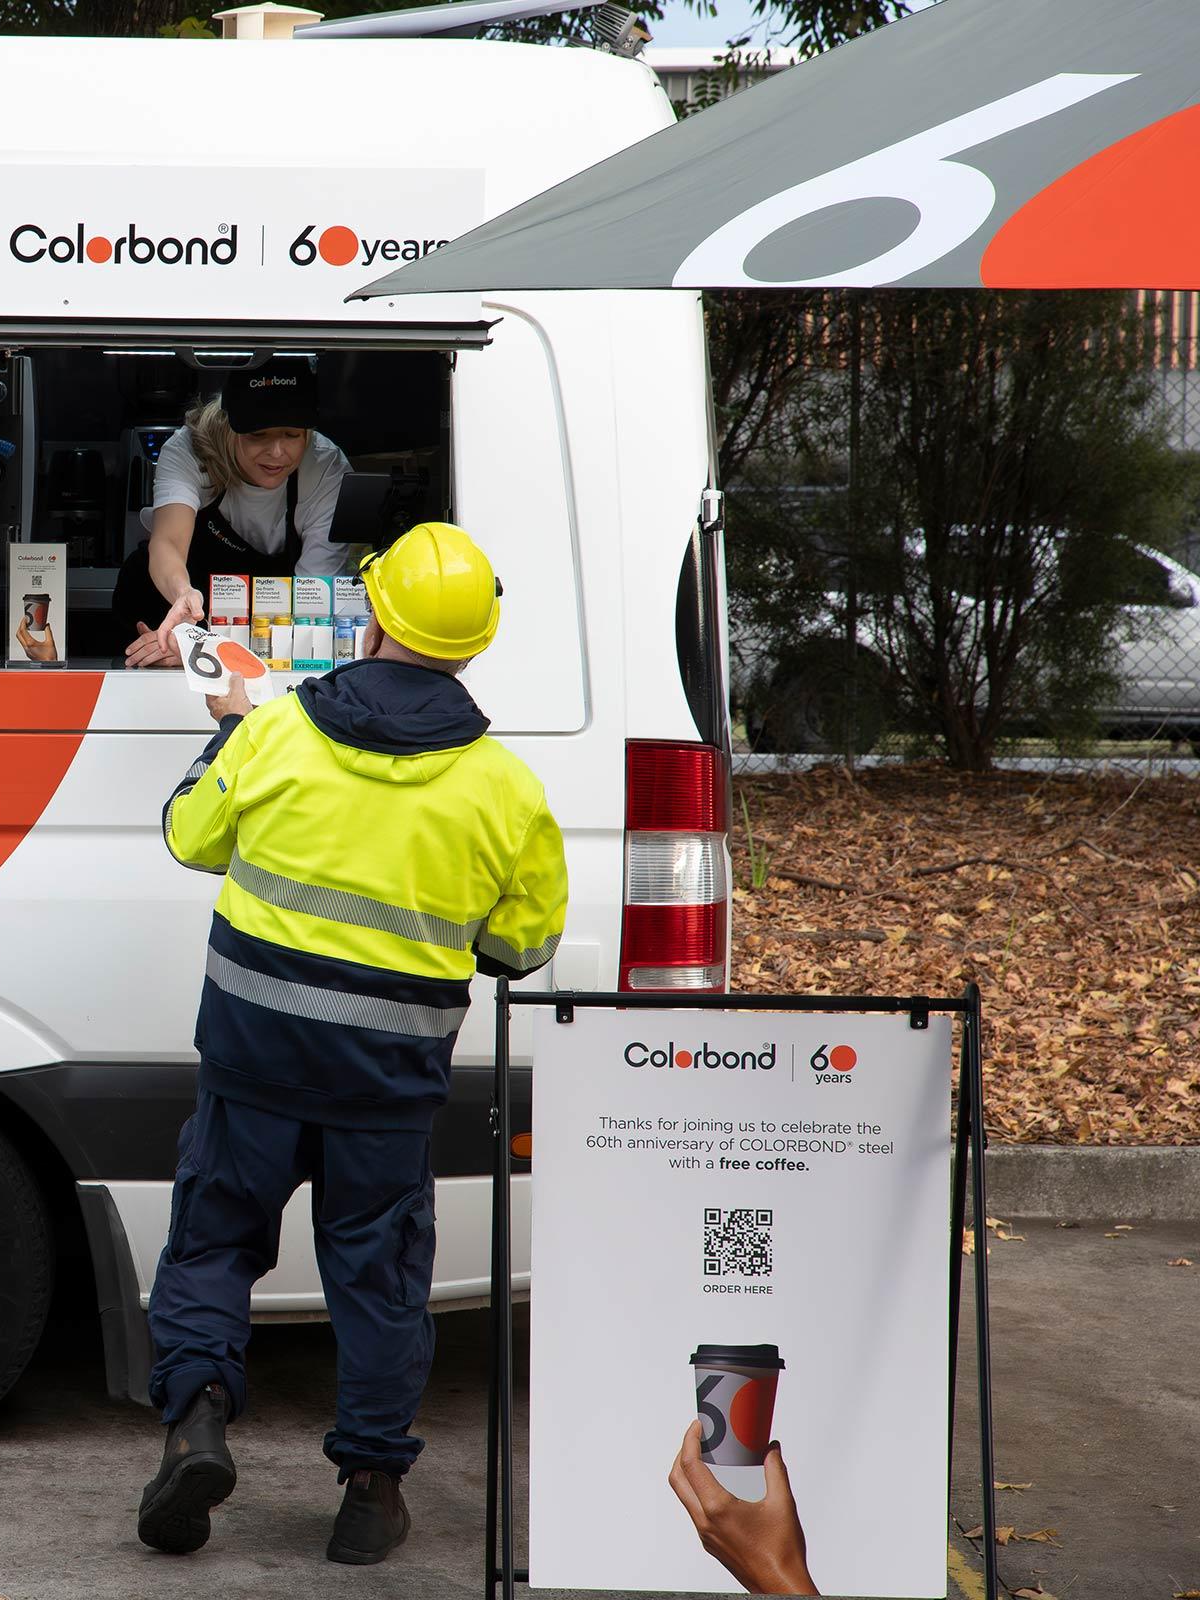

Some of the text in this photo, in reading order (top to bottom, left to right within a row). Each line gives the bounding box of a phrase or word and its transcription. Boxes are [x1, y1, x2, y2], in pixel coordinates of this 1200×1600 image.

[249, 375, 297, 388] Colorbond
[814, 1072, 852, 1085] years
[599, 1116, 882, 1135] Thanks for joining us to celebrate the
[586, 1135, 622, 1149] 60th
[627, 1138, 714, 1153] anniversary
[719, 1137, 735, 1151] of
[858, 1140, 894, 1155] steel
[668, 1156, 810, 1172] with a free coffee.
[702, 1284, 773, 1295] ORDER HERE
